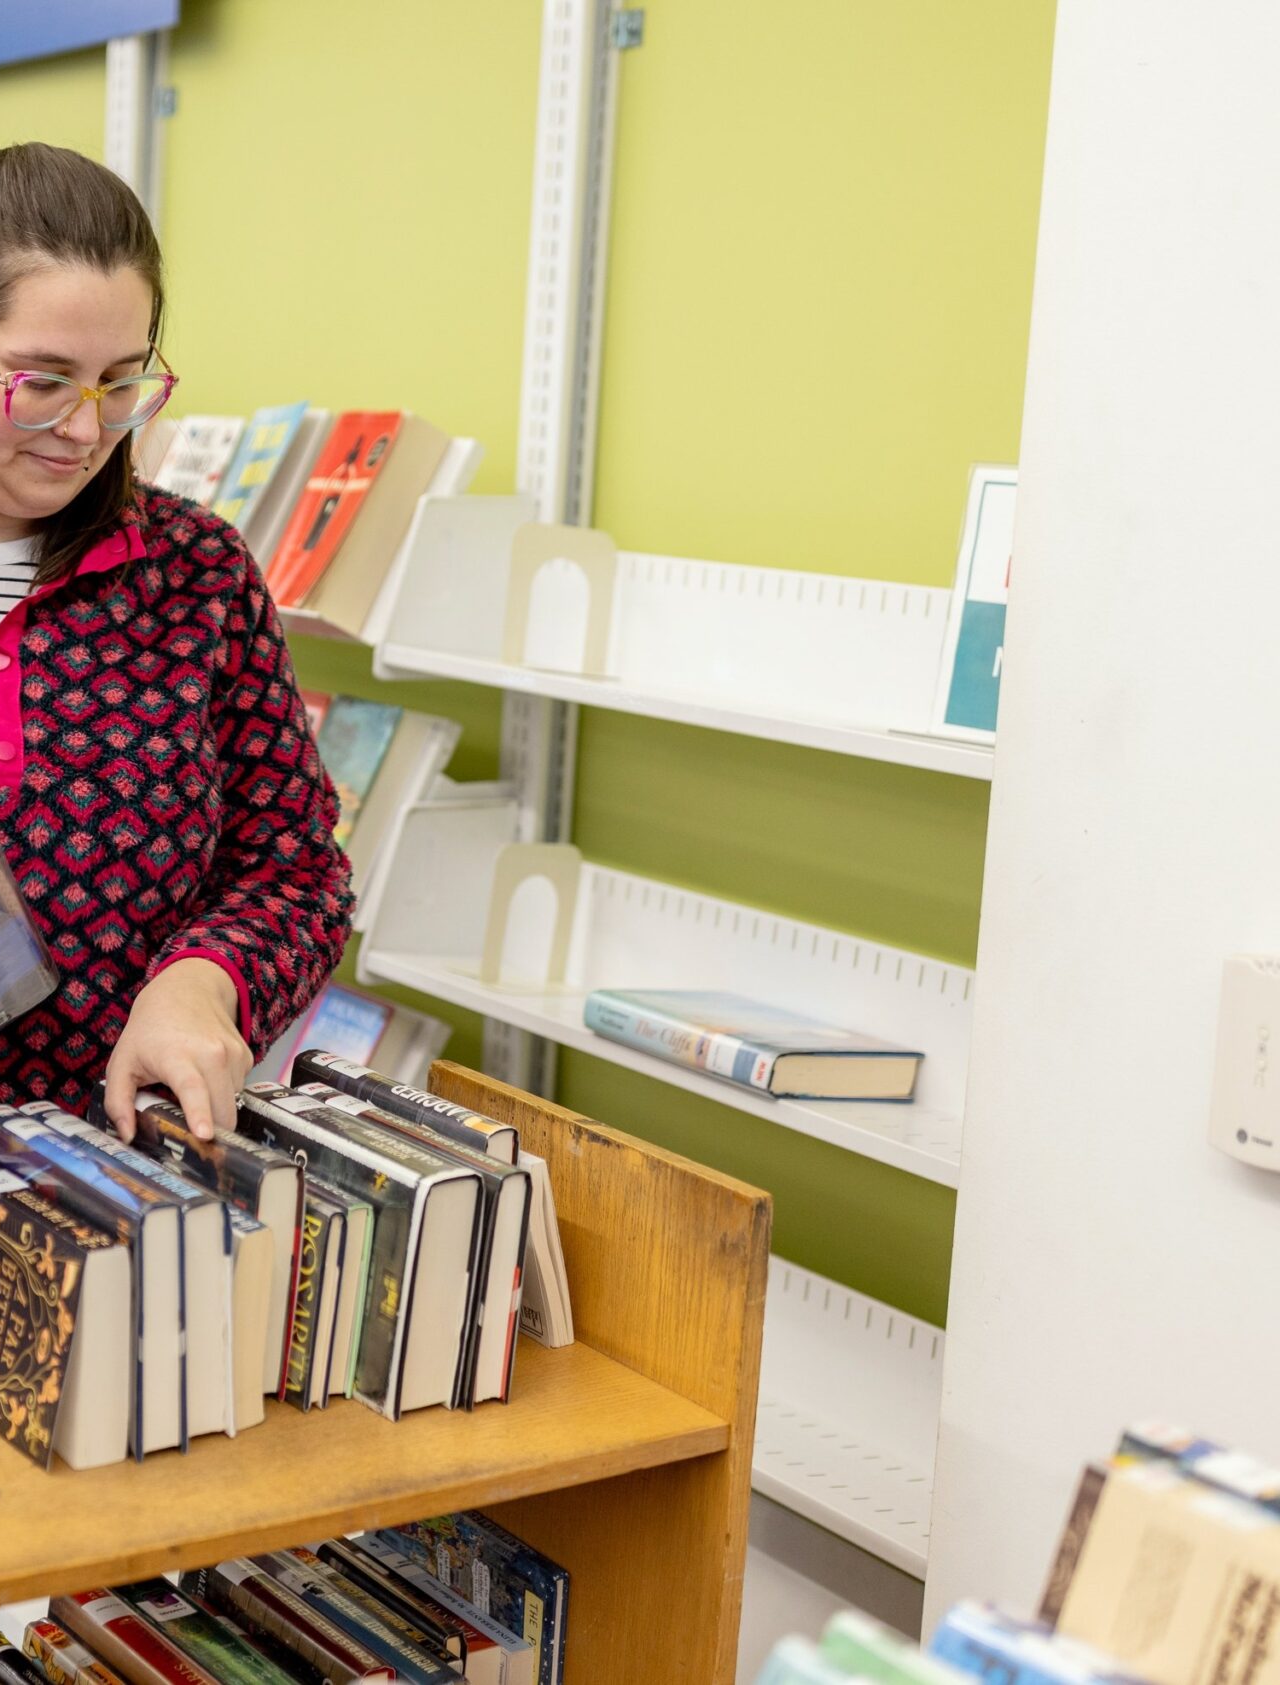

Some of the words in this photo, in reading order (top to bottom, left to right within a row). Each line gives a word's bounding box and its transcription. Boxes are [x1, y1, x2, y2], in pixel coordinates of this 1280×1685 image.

[634, 1019, 658, 1040] The
[659, 1025, 691, 1053] Cliffs
[391, 1085, 460, 1120] ARCHER
[368, 1129, 445, 1167] GALBRAITH
[370, 1140, 410, 1160] ROBERT
[2, 1313, 25, 1369] FAR
[464, 1608, 498, 1632] FERRANTE
[526, 1602, 539, 1628] THE
[358, 1617, 407, 1648] CONNELLY
[493, 1629, 517, 1645] ELENA
[396, 1645, 442, 1674] MICHAEL
